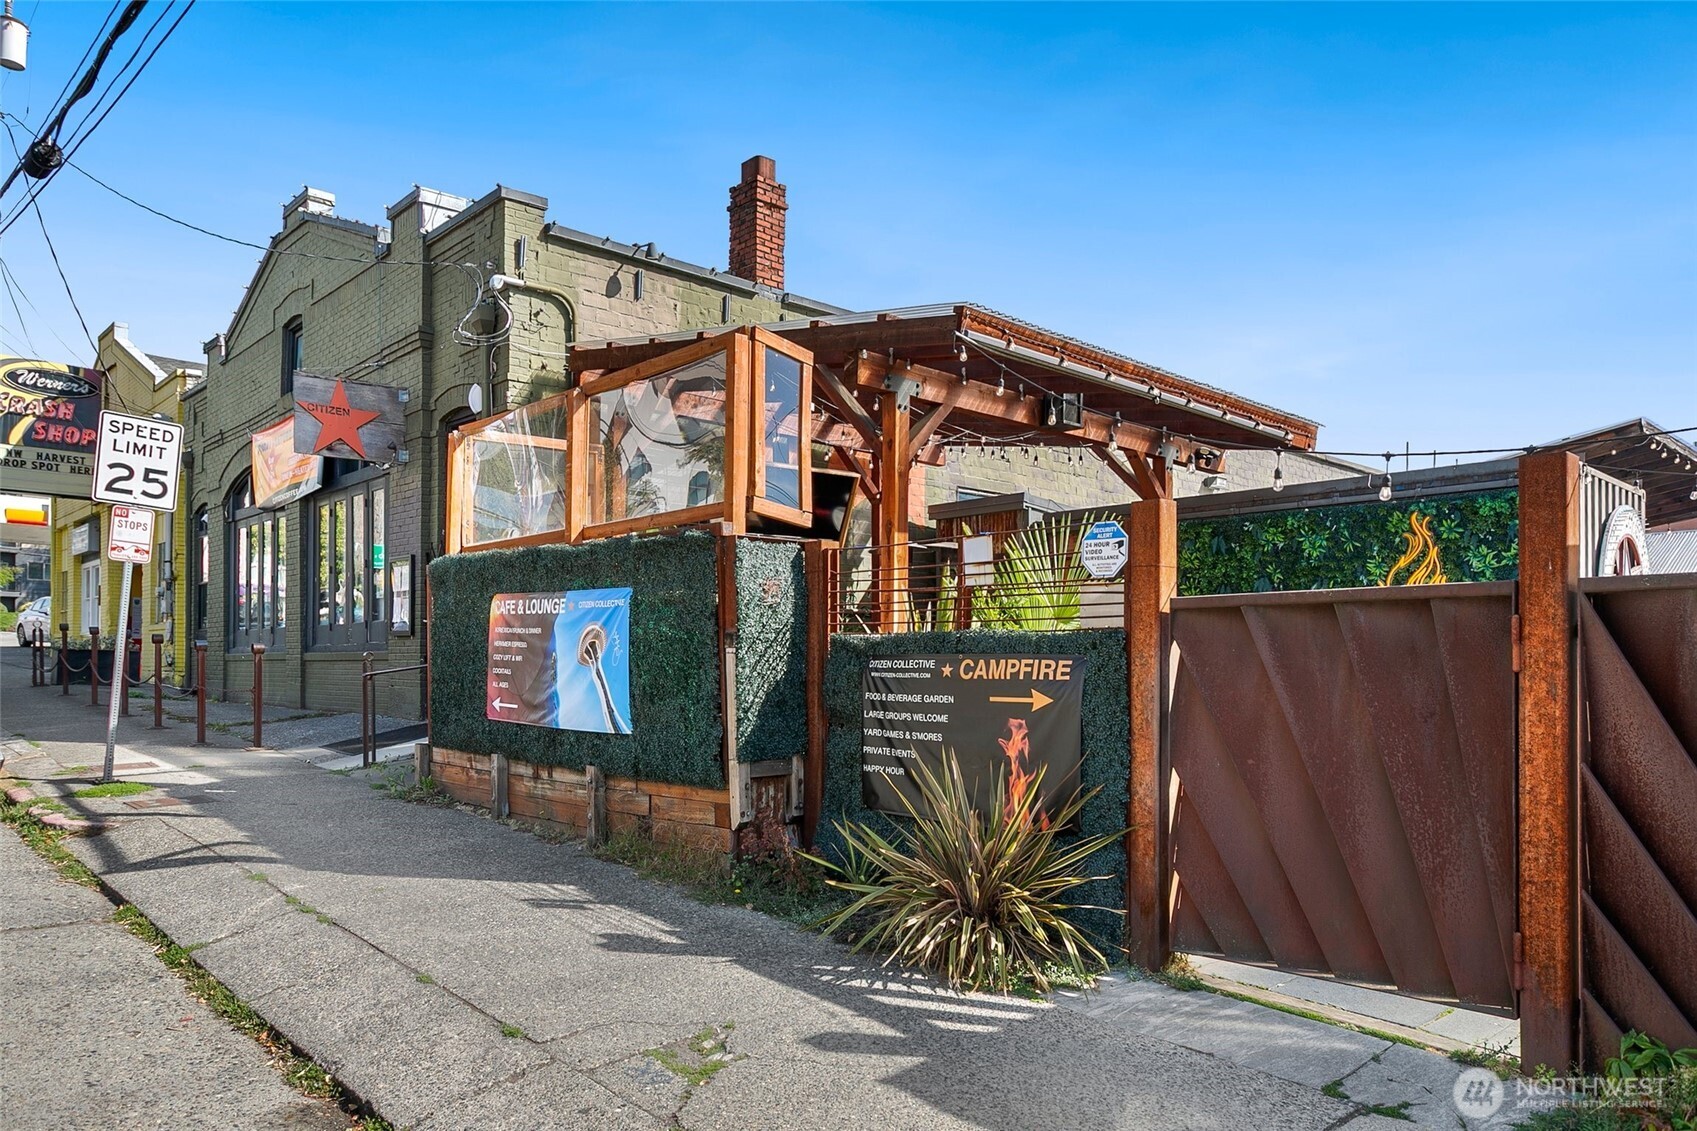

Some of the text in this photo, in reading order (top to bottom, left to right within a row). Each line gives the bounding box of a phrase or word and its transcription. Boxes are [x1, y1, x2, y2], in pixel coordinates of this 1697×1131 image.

[16, 369, 89, 394] Werner's
[0, 391, 75, 421] CRASH
[307, 402, 350, 417] CITIZEN
[31, 421, 97, 446] SHOP
[108, 420, 174, 443] SPEED
[112, 438, 167, 459] LIMIT
[0, 458, 26, 469] ROP
[31, 461, 60, 472] SPOT
[36, 452, 86, 465] HARVEST
[104, 462, 168, 499] 25
[115, 508, 128, 517] NO
[117, 519, 148, 531] STOPS
[494, 598, 566, 615] CAFE & LOUNGE
[869, 658, 1073, 681] CITIZEN COLLECTIVE CAMPFIRE
[865, 692, 954, 704] FOOD & BEVERAGE GARDEN
[863, 710, 949, 723] LARGE GROUPS WELCOME
[863, 728, 943, 742] YARD GAMES & S'MORES
[863, 746, 916, 759] PRIVATE EVENTS
[863, 764, 905, 776] HAPPY HOUR
